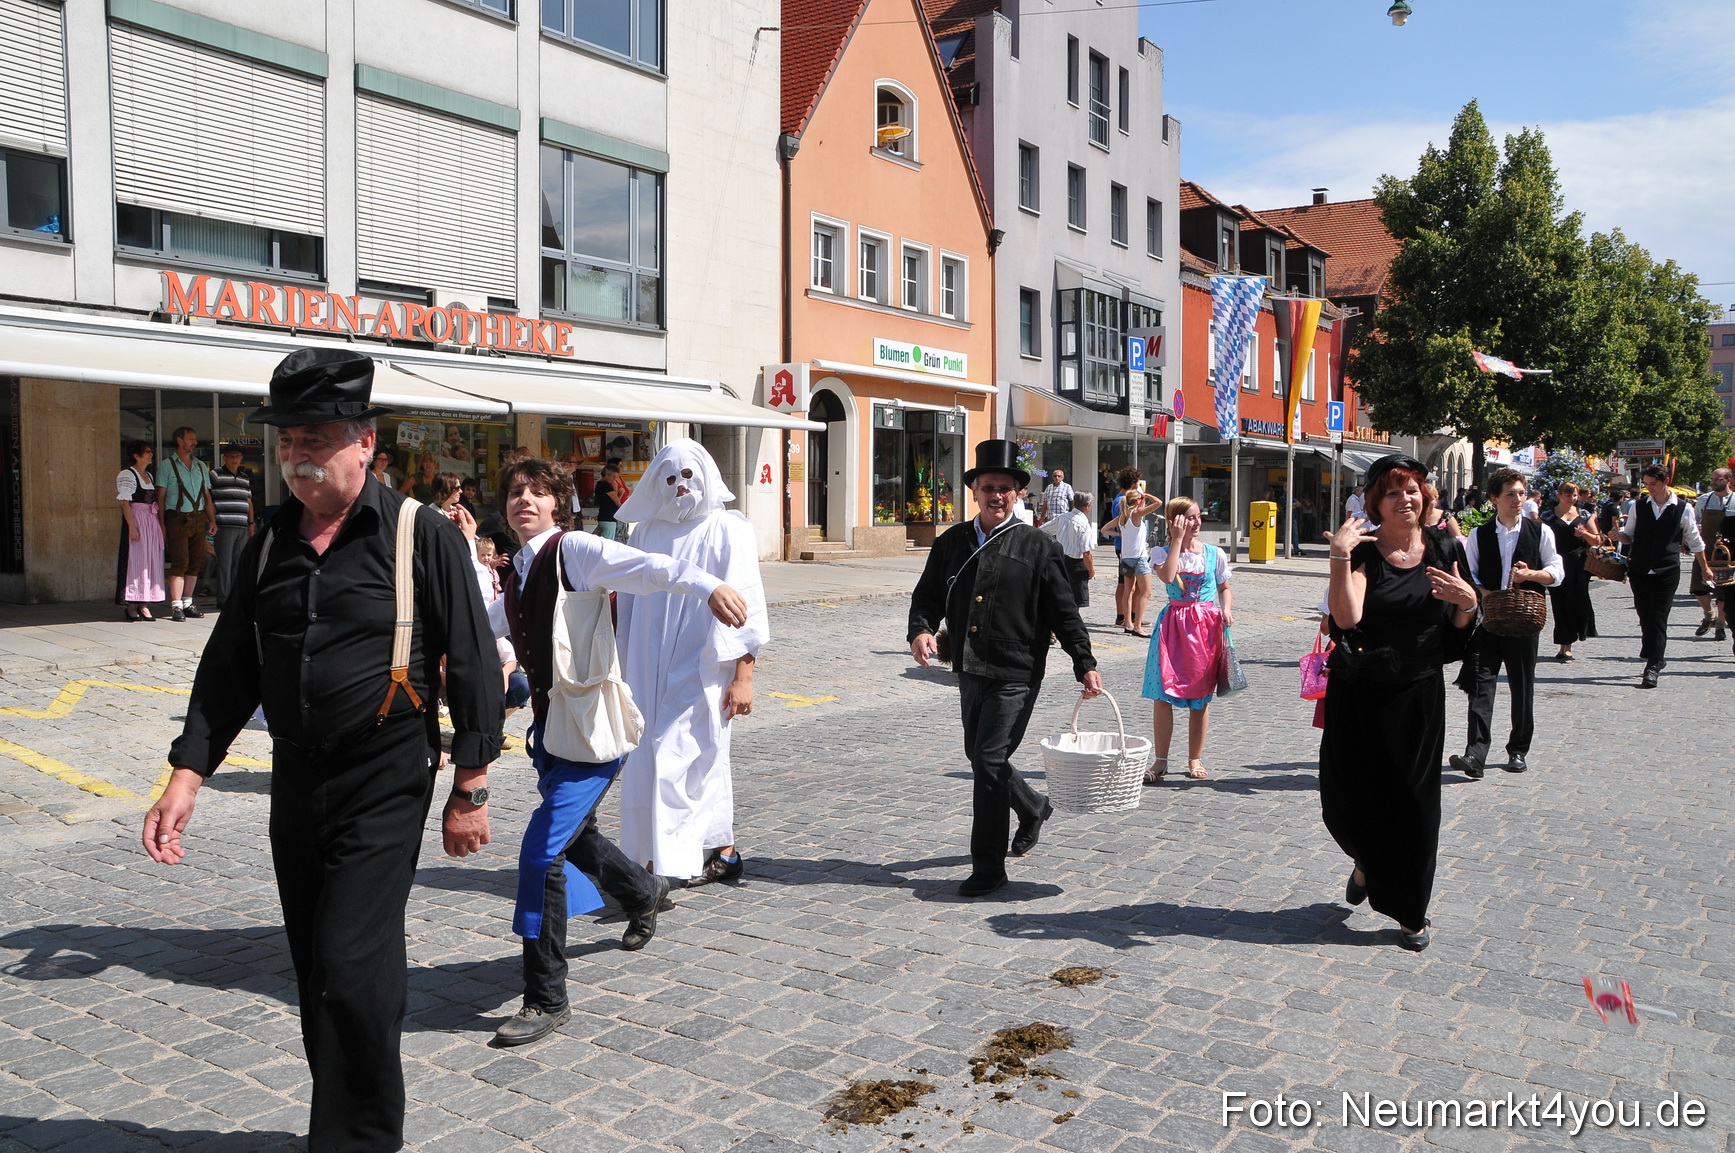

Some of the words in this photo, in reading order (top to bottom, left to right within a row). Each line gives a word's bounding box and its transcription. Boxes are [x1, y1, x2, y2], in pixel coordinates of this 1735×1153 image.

[162, 270, 575, 357] MARIEN-APOTHEKE
[879, 344, 910, 364] Blumen
[923, 353, 941, 369] Grün
[943, 355, 963, 373] Punkt
[1243, 418, 1284, 436] TABAKWARE
